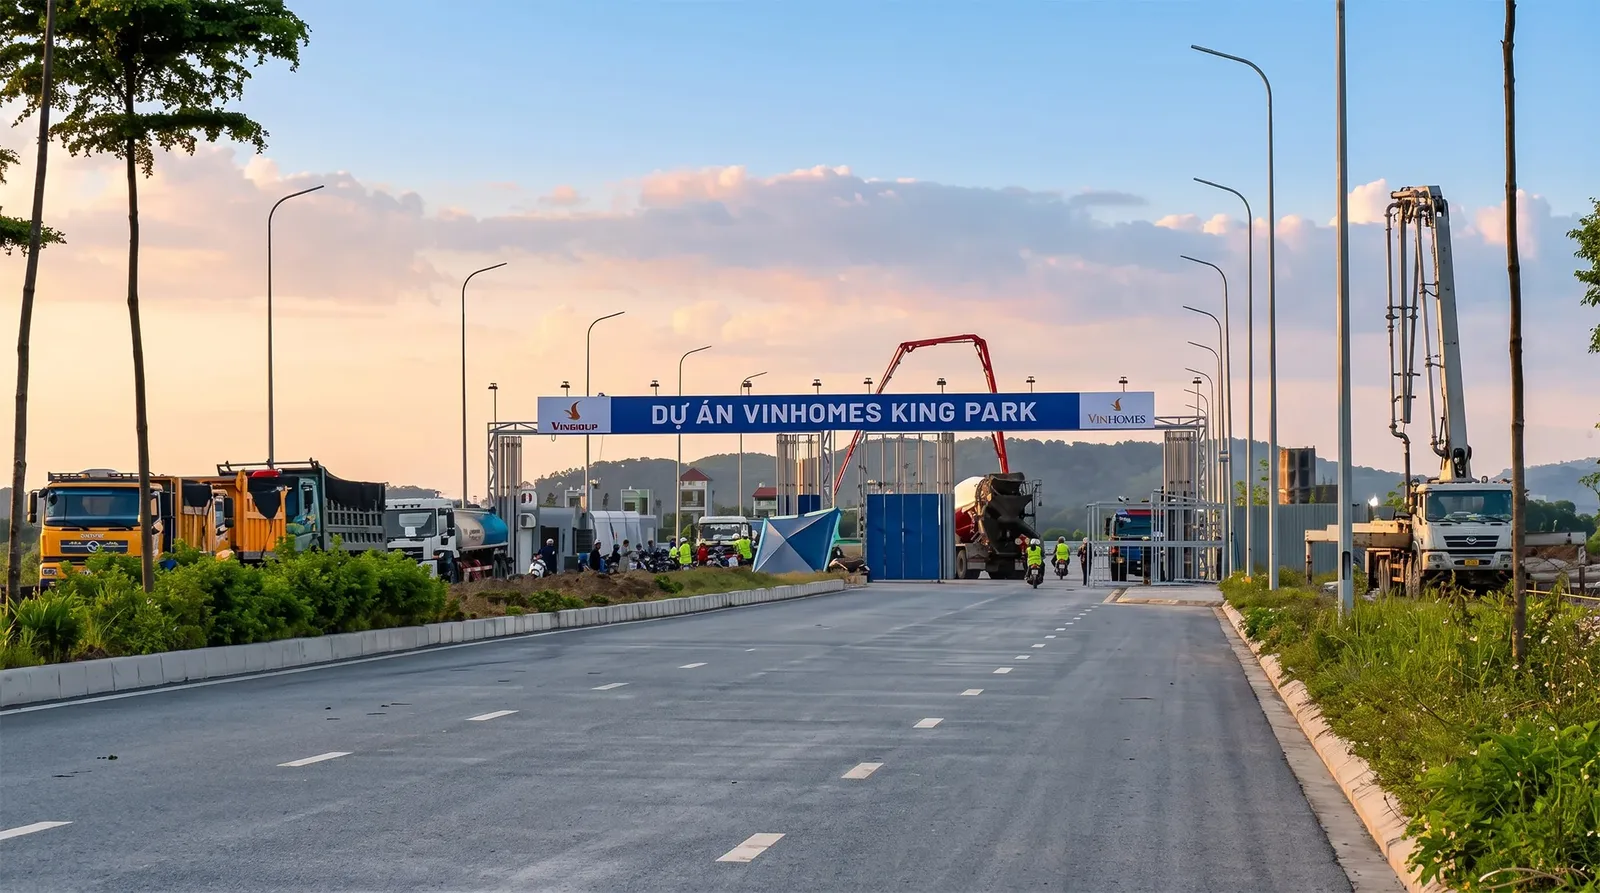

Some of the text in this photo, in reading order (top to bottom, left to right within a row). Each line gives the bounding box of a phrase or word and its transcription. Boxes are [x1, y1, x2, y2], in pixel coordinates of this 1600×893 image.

[653, 400, 1037, 429] DỰ ÁN VINHOMES KING PARK
[1087, 413, 1146, 424] VINHOMES
